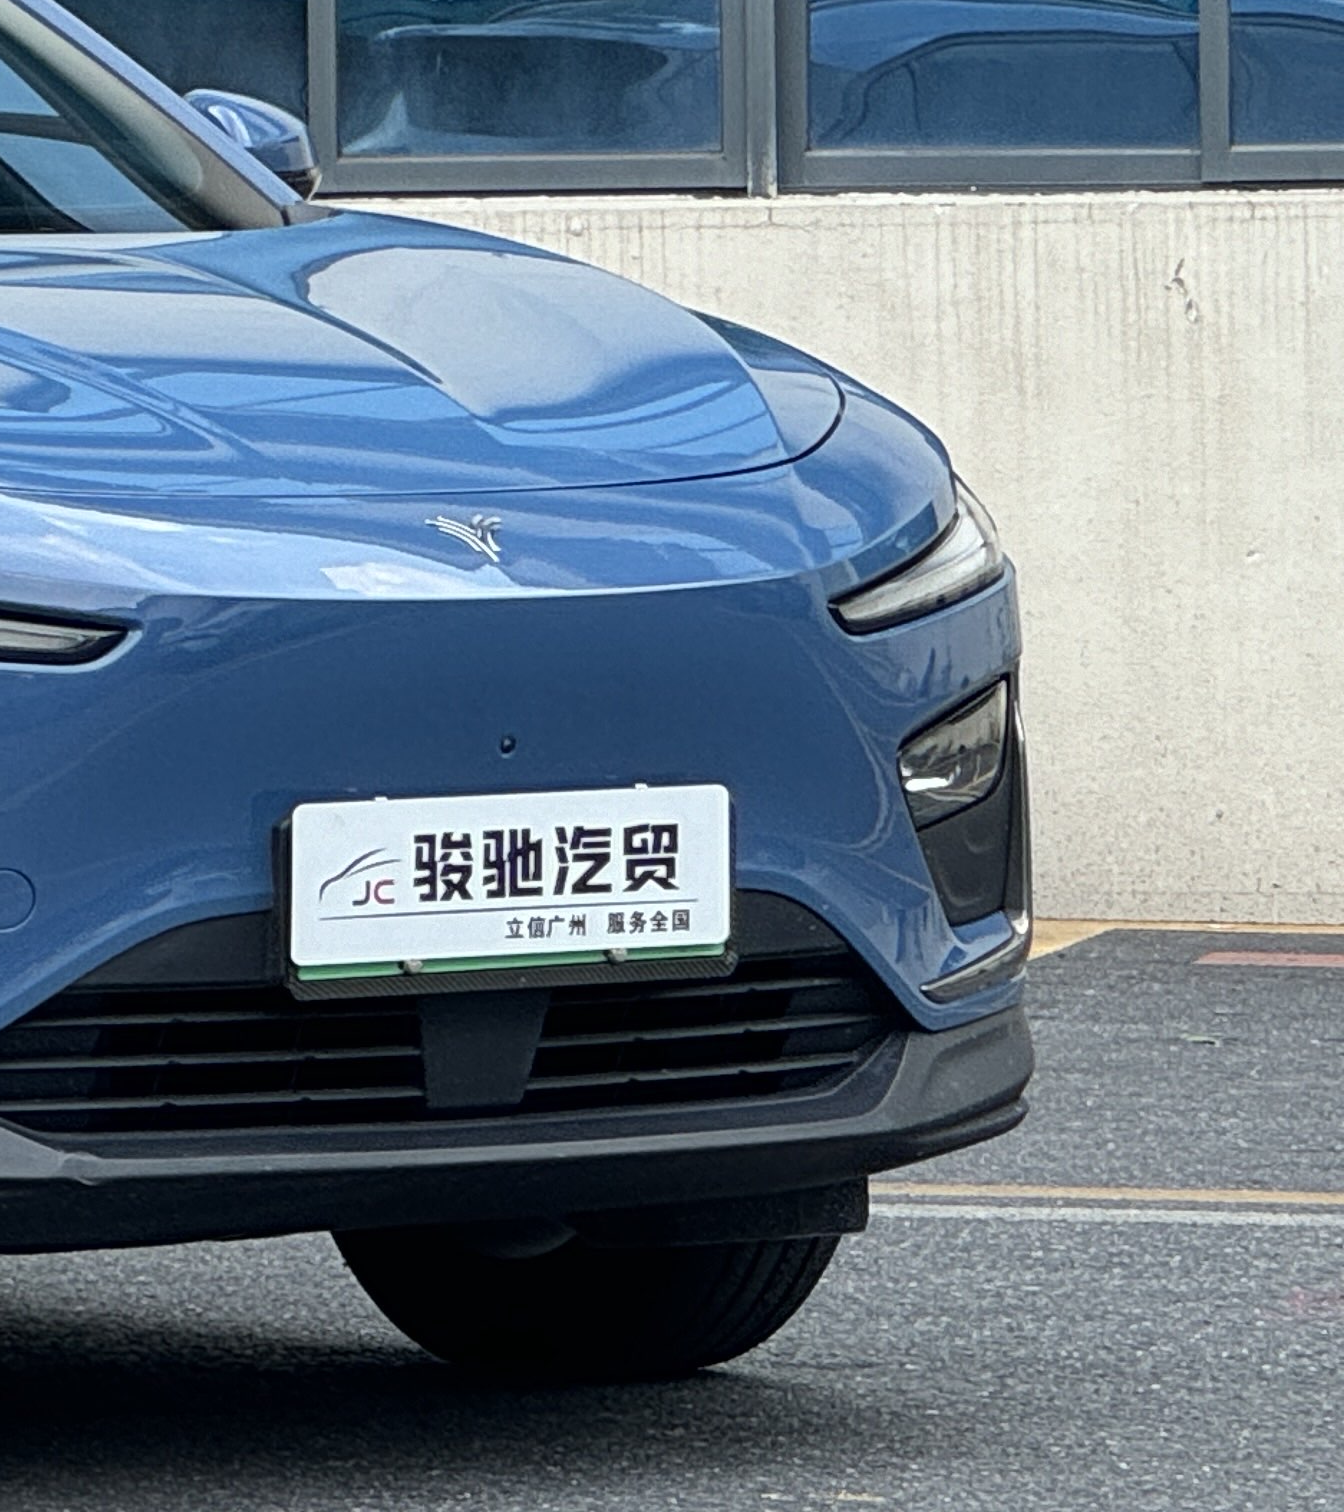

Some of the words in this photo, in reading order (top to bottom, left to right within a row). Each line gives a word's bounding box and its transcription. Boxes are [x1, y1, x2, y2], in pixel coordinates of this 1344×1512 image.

[413, 823, 681, 902] 骏驰汽贸
[352, 878, 395, 907] JC
[505, 913, 587, 940] 立信广州
[607, 908, 691, 934] 服务全国
